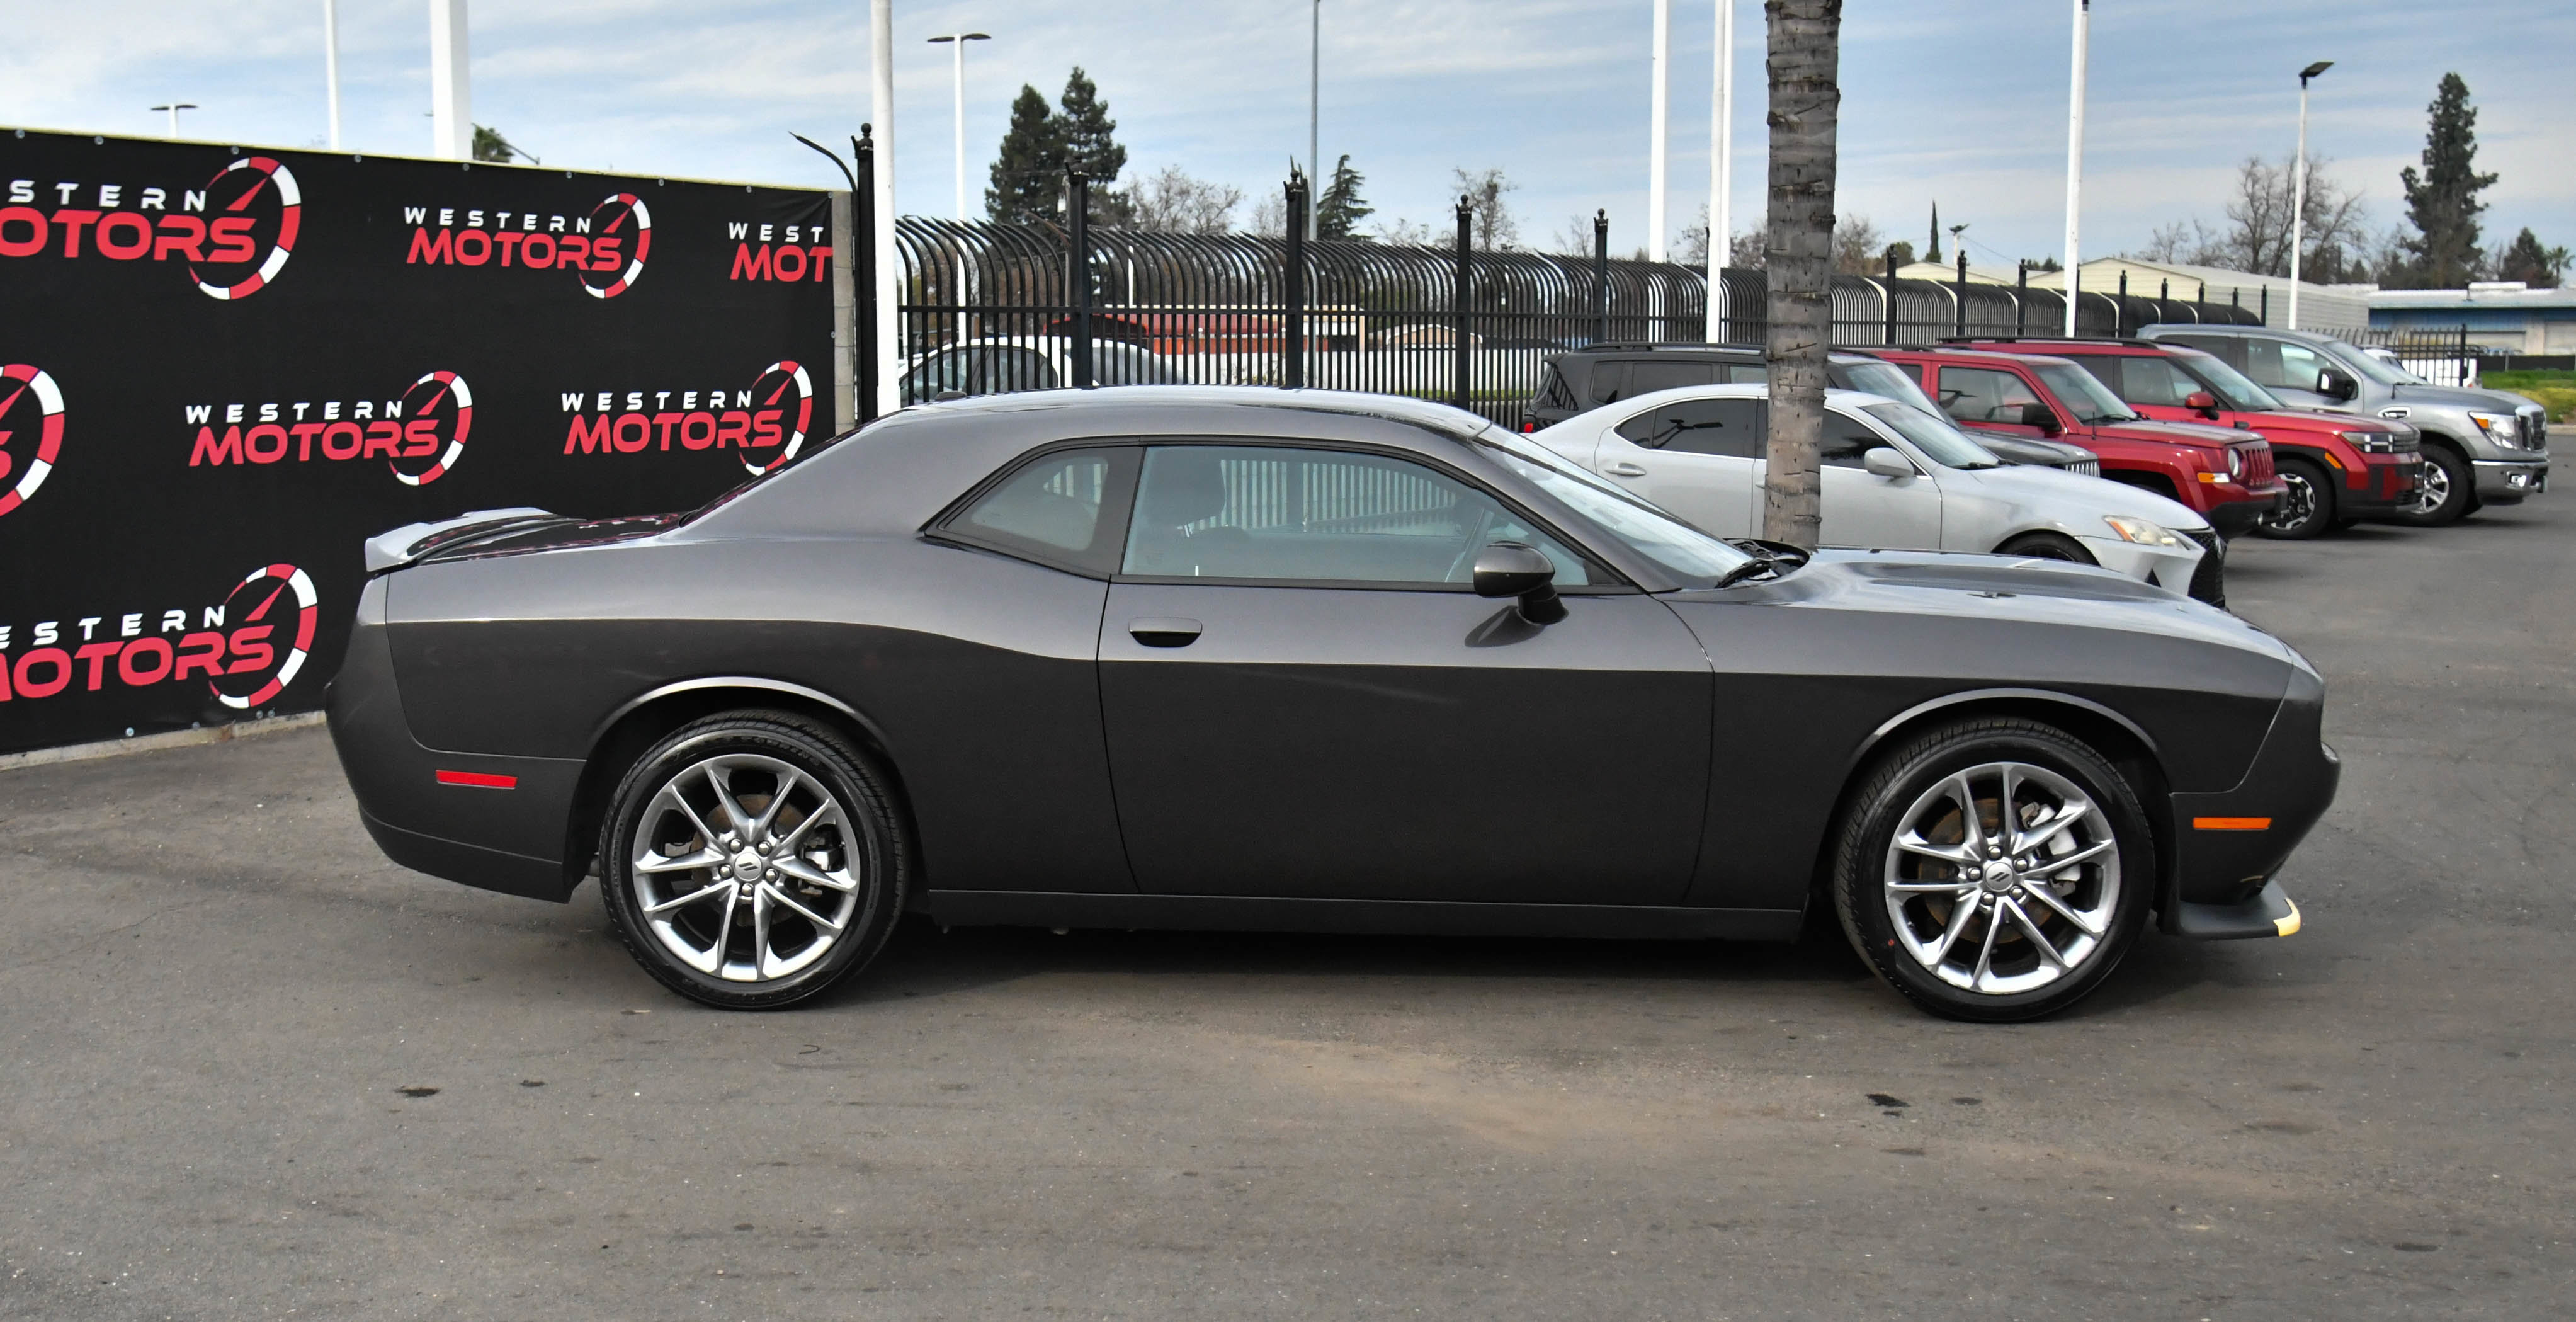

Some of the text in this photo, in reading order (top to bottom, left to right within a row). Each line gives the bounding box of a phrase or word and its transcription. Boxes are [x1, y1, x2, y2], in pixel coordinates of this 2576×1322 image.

[0, 207, 256, 262] OTORS
[404, 207, 591, 234] WESTERN
[729, 222, 824, 244] WEST
[407, 227, 622, 271] MOTORS
[730, 243, 834, 282] MOT
[186, 401, 402, 425] WESTERN
[562, 391, 752, 412] WESTERN
[189, 419, 439, 466] MOTORS
[564, 410, 783, 454] MOTORS
[0, 625, 275, 702] OTORS
